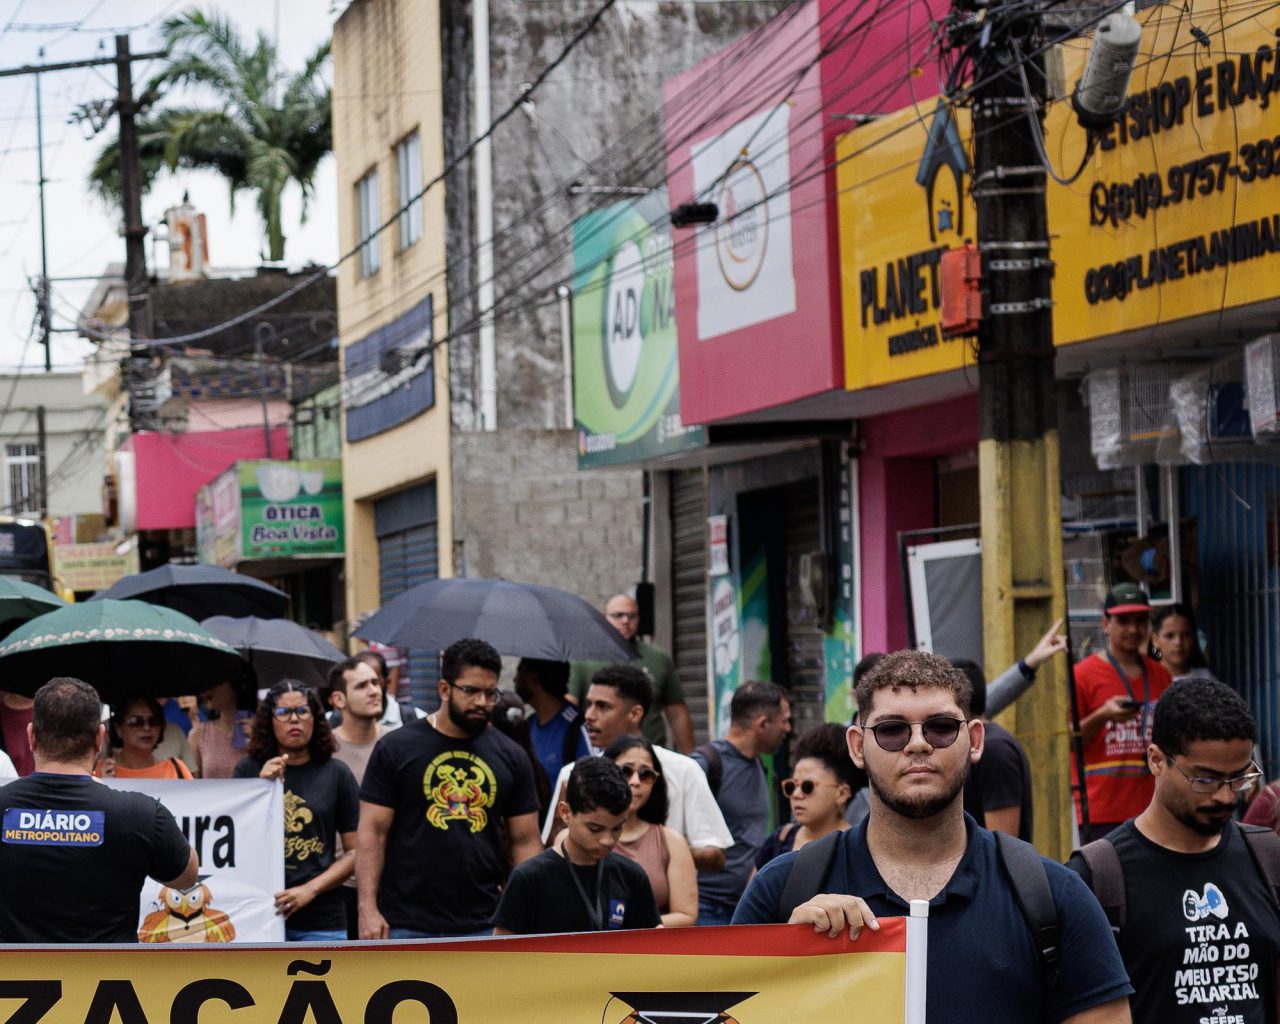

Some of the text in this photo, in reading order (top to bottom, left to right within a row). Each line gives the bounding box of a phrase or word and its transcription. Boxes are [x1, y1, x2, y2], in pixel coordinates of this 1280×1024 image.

[1100, 75, 1191, 152] ETSHOP
[860, 244, 949, 329] PLANET
[19, 809, 91, 831] DIÁRIO
[5, 829, 100, 842] METROPOLITANO
[1185, 921, 1249, 943] TIRA A
[1183, 942, 1250, 965] MÃO DO
[1174, 962, 1259, 988] MEU PISO
[1175, 982, 1260, 1005] SALARIAL
